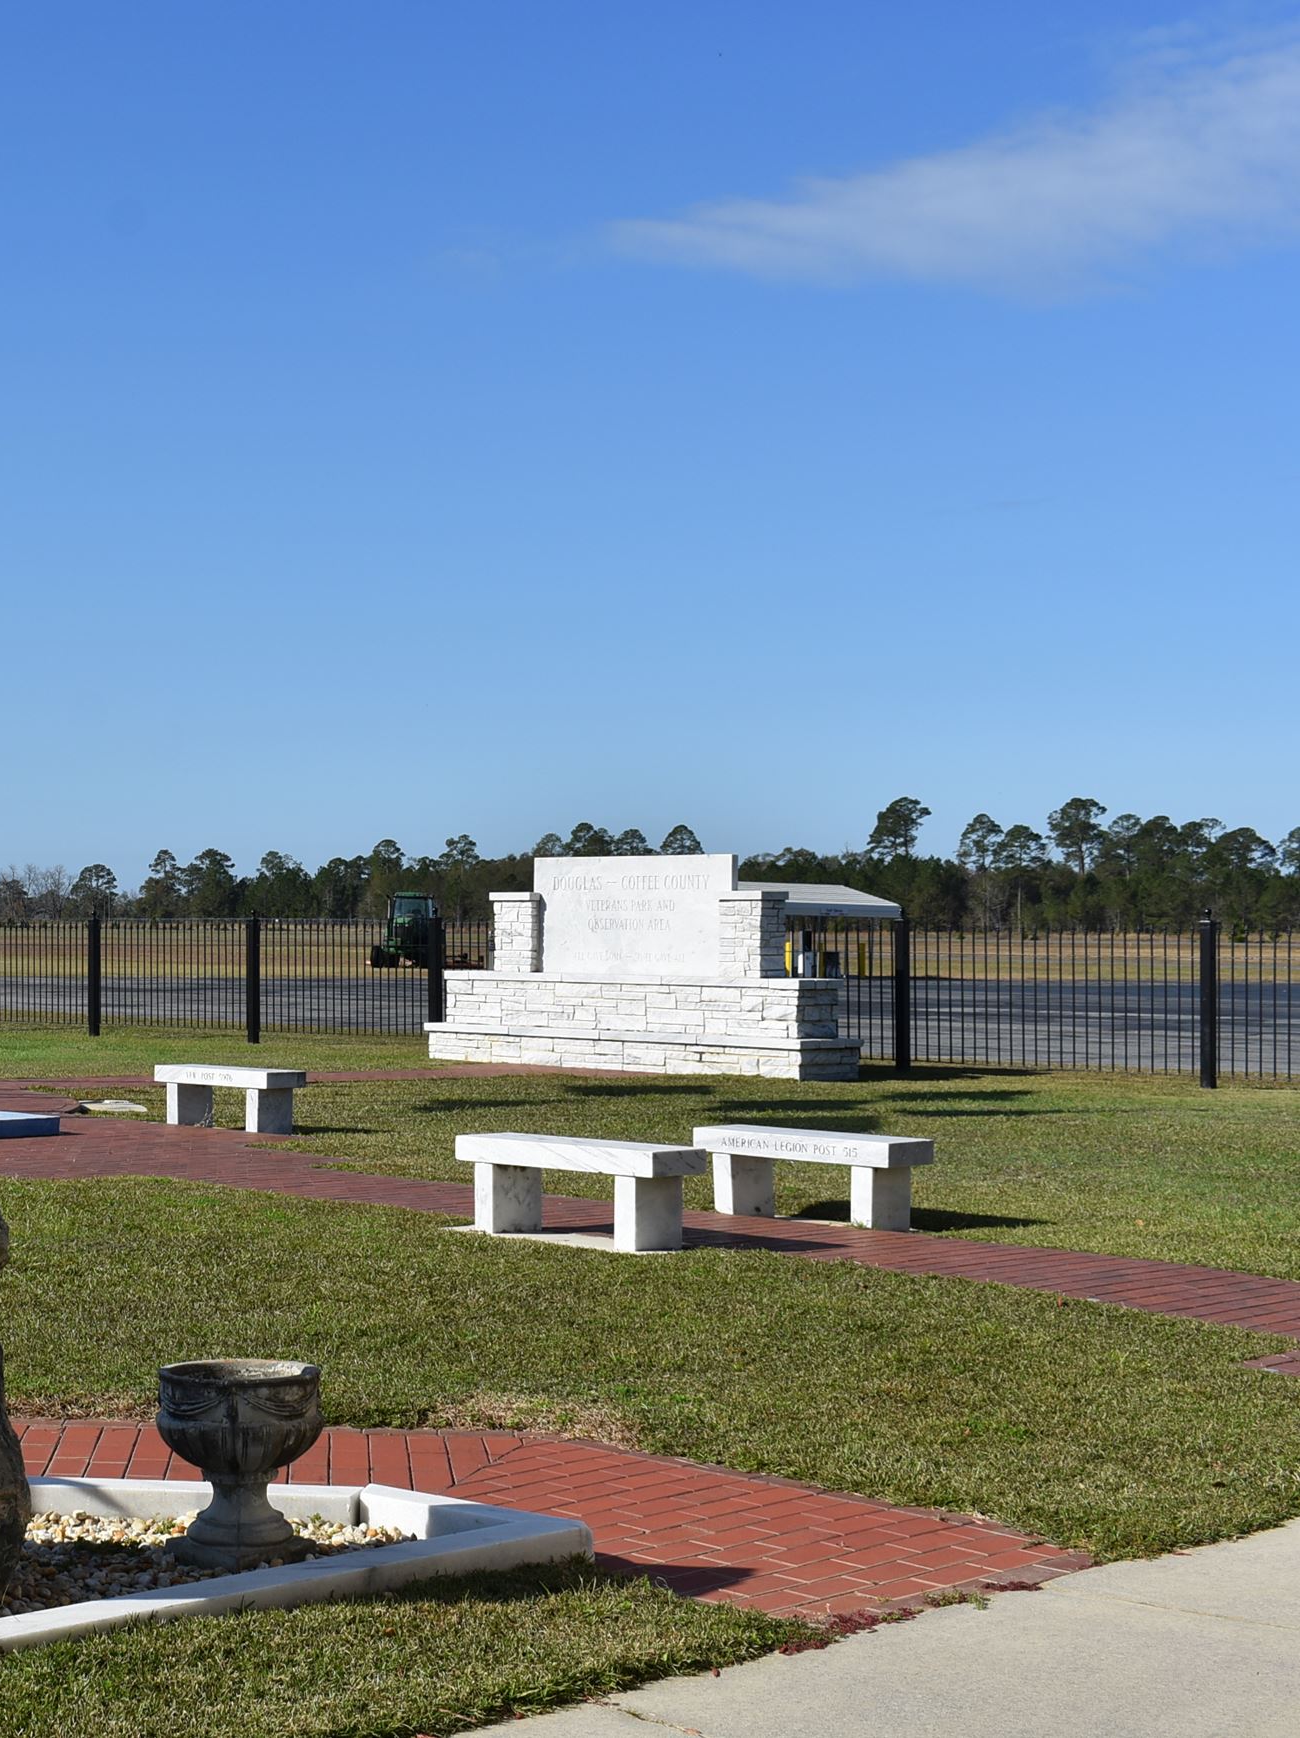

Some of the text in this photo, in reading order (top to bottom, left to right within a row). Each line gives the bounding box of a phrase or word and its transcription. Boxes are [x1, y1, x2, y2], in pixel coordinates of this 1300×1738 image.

[552, 875, 603, 891] DOUGLAS
[621, 874, 660, 890] COFFEE
[663, 873, 711, 890] COUNTY
[585, 899, 676, 912] VETERANS PARK AND
[587, 918, 672, 931] OBSERVATION AREA
[720, 1136, 858, 1158] AMERICAN LEGION POST 515
